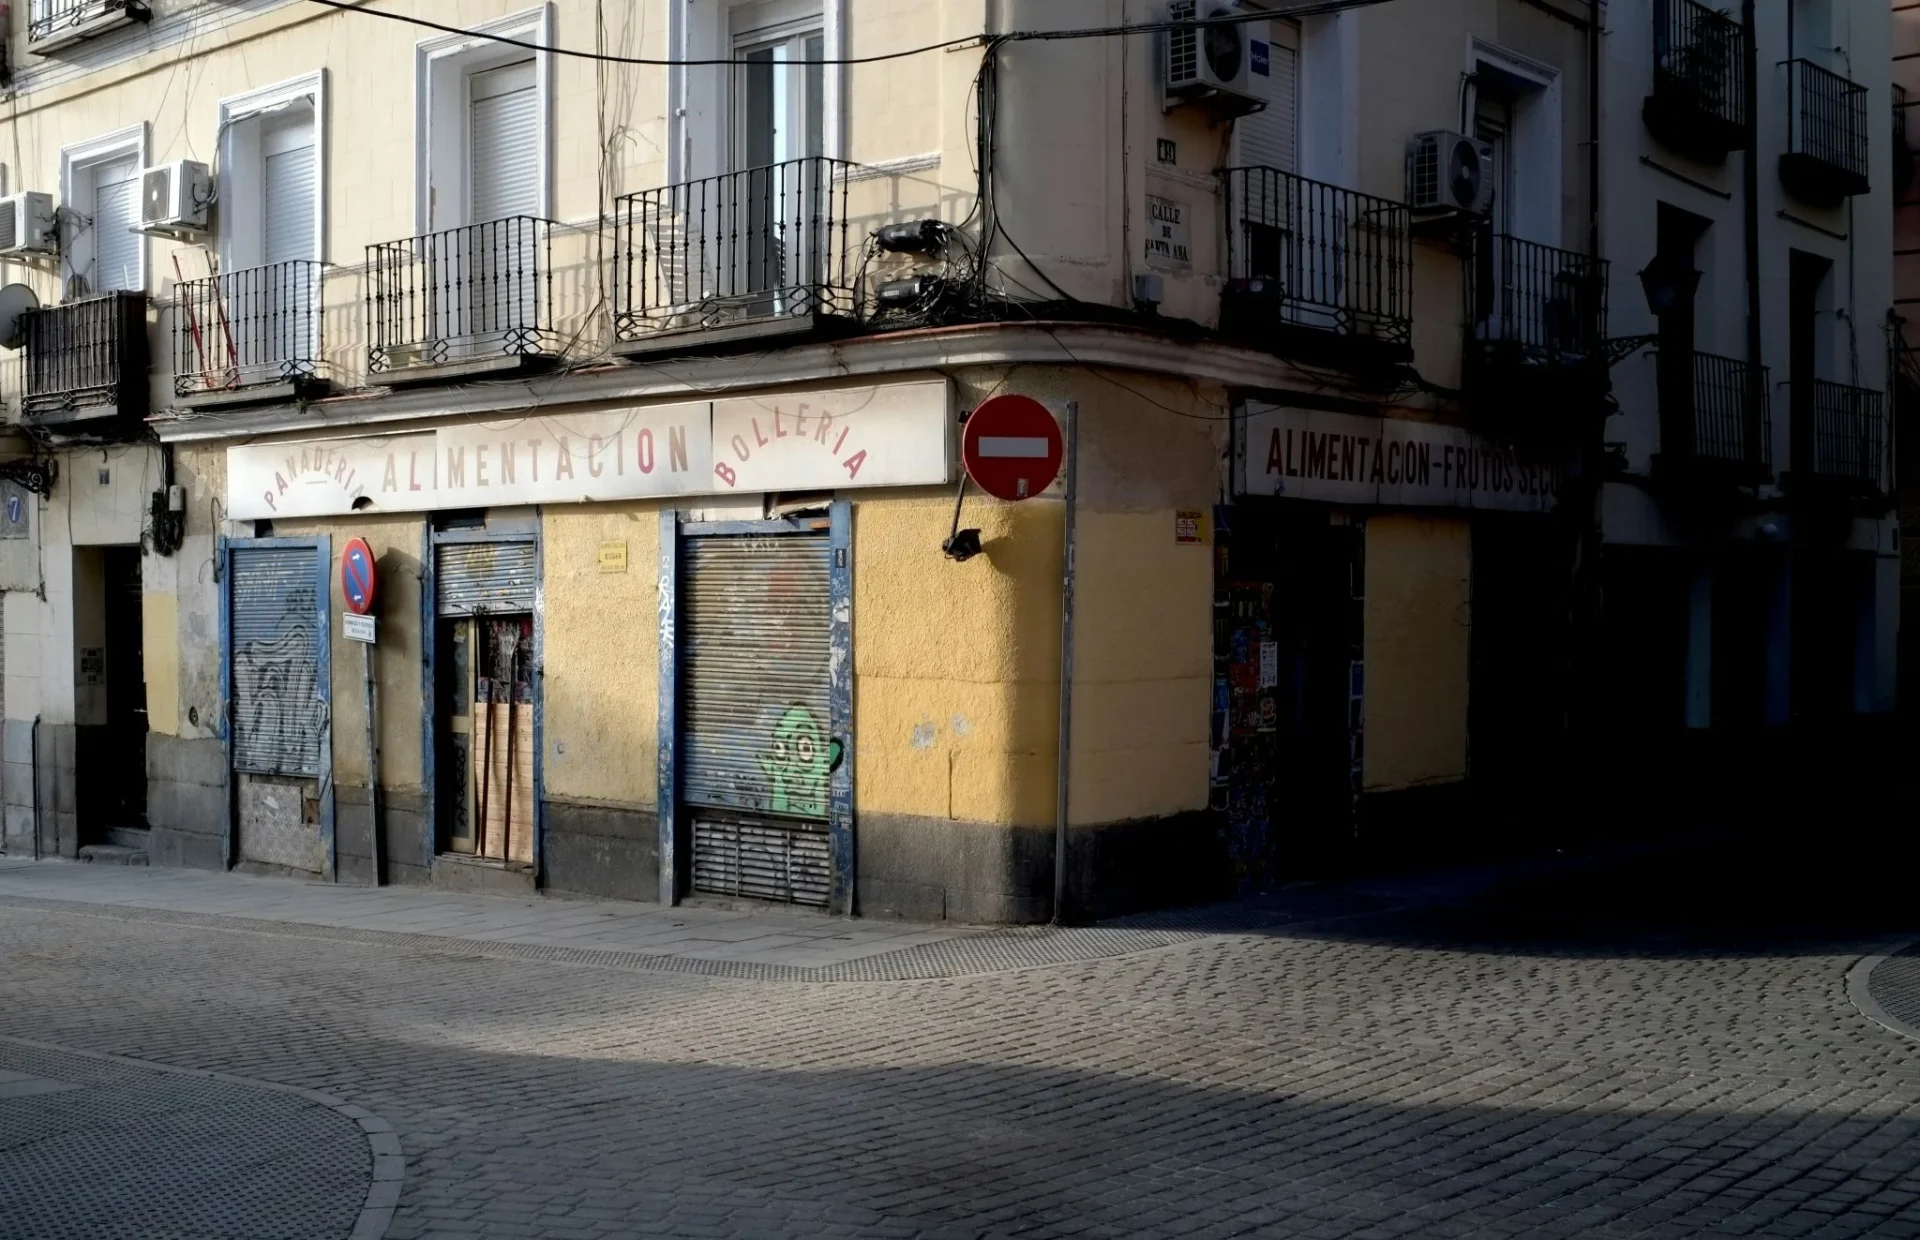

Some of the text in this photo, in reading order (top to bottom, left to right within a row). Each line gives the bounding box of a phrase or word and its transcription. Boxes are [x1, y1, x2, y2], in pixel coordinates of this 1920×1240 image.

[1152, 204, 1181, 224] CALLE
[1162, 225, 1172, 239] DE
[1173, 243, 1188, 261] ANA
[714, 404, 868, 487] BOLLERIA
[264, 425, 689, 512] PANADERIA ALIMENTACION
[10, 496, 19, 521] 7
